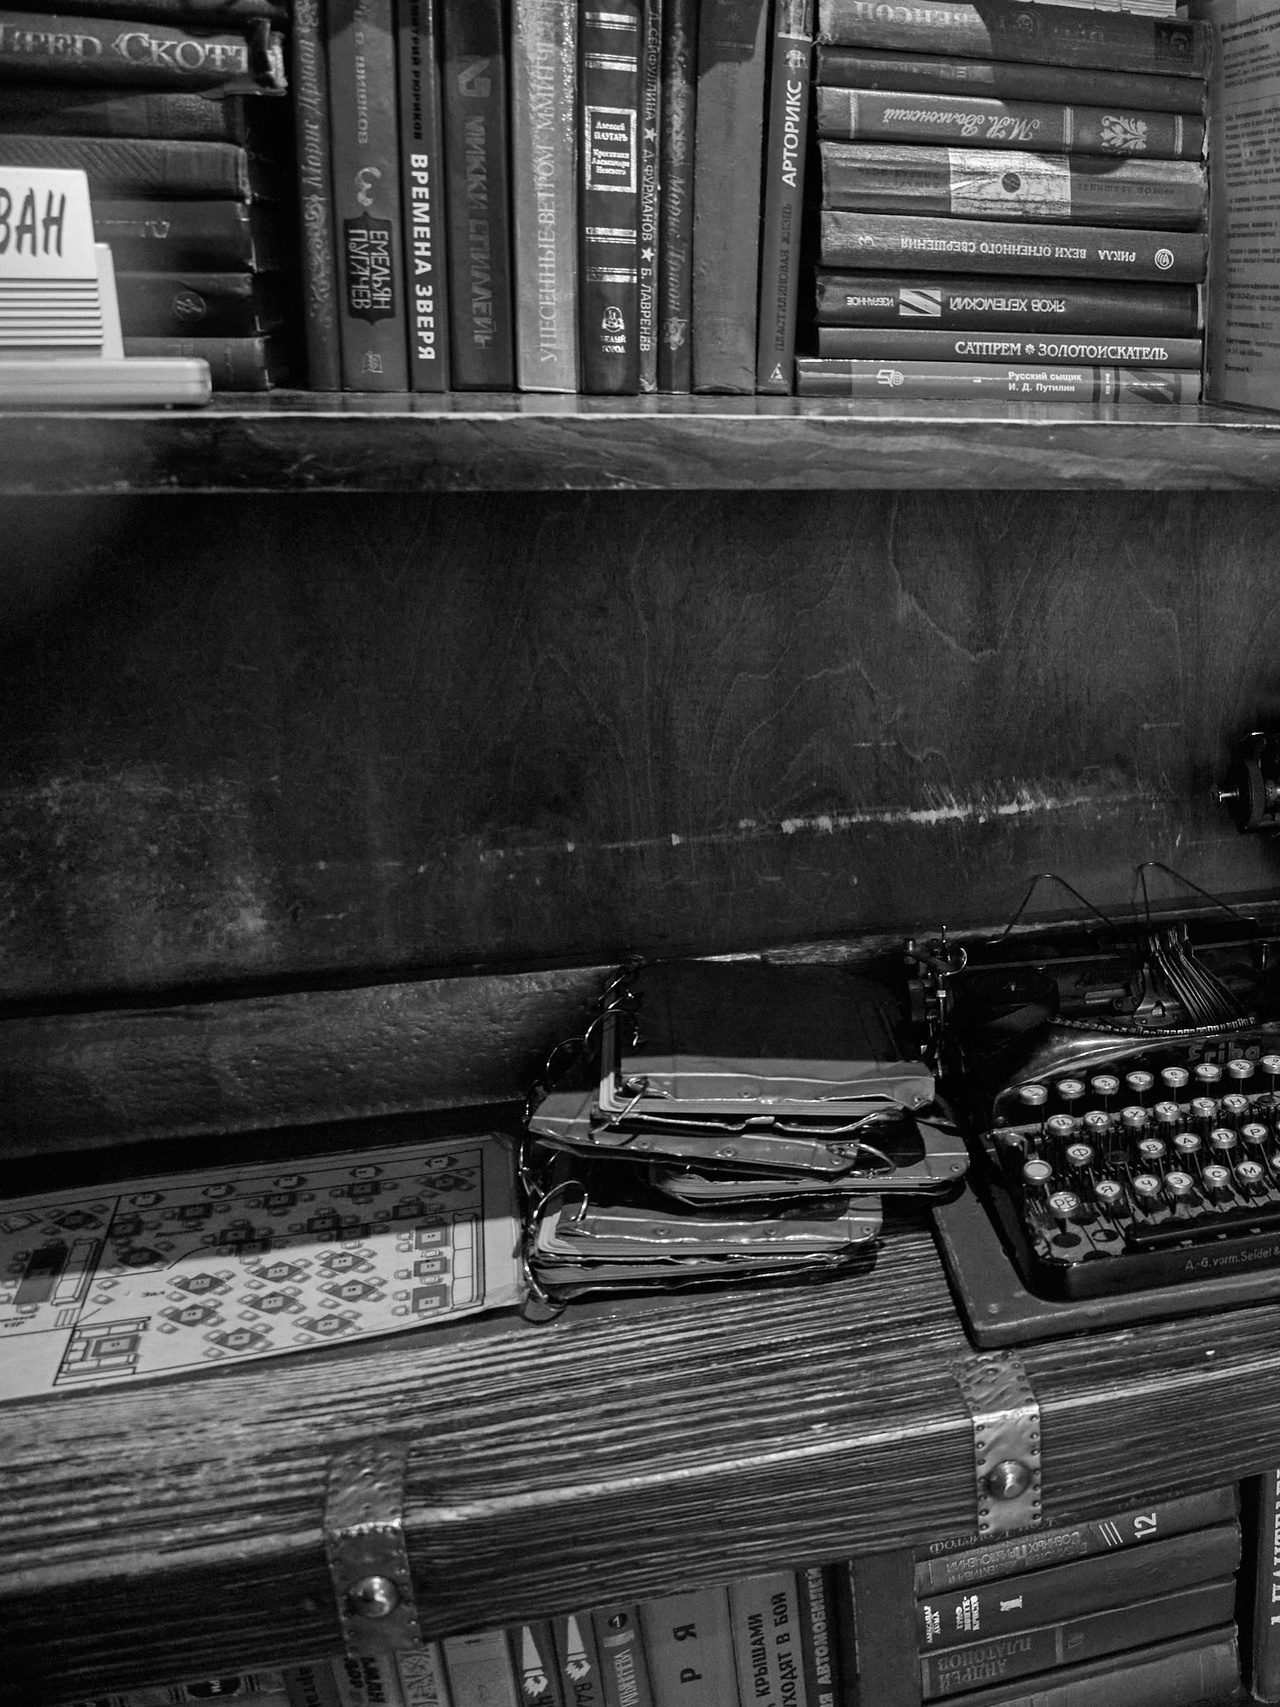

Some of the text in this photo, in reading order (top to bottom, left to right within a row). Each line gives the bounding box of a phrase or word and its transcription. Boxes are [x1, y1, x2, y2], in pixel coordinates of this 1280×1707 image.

[412, 69, 424, 141] РЮРИКОВ
[645, 29, 658, 121] СЕЙФУЛЛИНА
[781, 80, 803, 188] АРТОРИКС
[882, 107, 985, 137] Волконский
[464, 115, 493, 351] МИККИ СПИЛЛЕЙН
[641, 165, 655, 241] ФУРМАНОВ
[349, 228, 371, 311] ПУГАЧЕВ
[368, 229, 391, 310] ЕМЕЛЬЯН
[410, 153, 436, 361] ВРЕМЕНА ЗВЕРЯ
[666, 173, 688, 313] Морис Дрюон
[774, 203, 791, 352] ПЛАСТИЛИНОВАЯ ЖИЗНЬ
[900, 237, 1136, 262] РИКЛА ВЕХИ ОГНЕННОГО СВЕРШЕНИЯ
[639, 284, 651, 352] ЛАВРЕНЕВ
[846, 296, 1066, 313] ЯКОВ ХЕЛЕМСКИЙ ИЗБРАННОЕ
[955, 342, 1169, 361] САТПРЕМ ЗОЛОТОИСКАТЕЛЬ
[1008, 371, 1083, 383] Русский сыщик
[1008, 382, 1076, 393] И. Д. Путилин
[1134, 1512, 1157, 1538] 12
[771, 1592, 790, 1627] БОЙ
[777, 1632, 791, 1644] В
[806, 1567, 832, 1685] АВТОМОБИЛЕЙ
[749, 1613, 771, 1698] КРЫШАМИ
[938, 1640, 1031, 1672] ПЛАТОНОВ
[939, 1661, 1008, 1692] АНДРЕЙ
